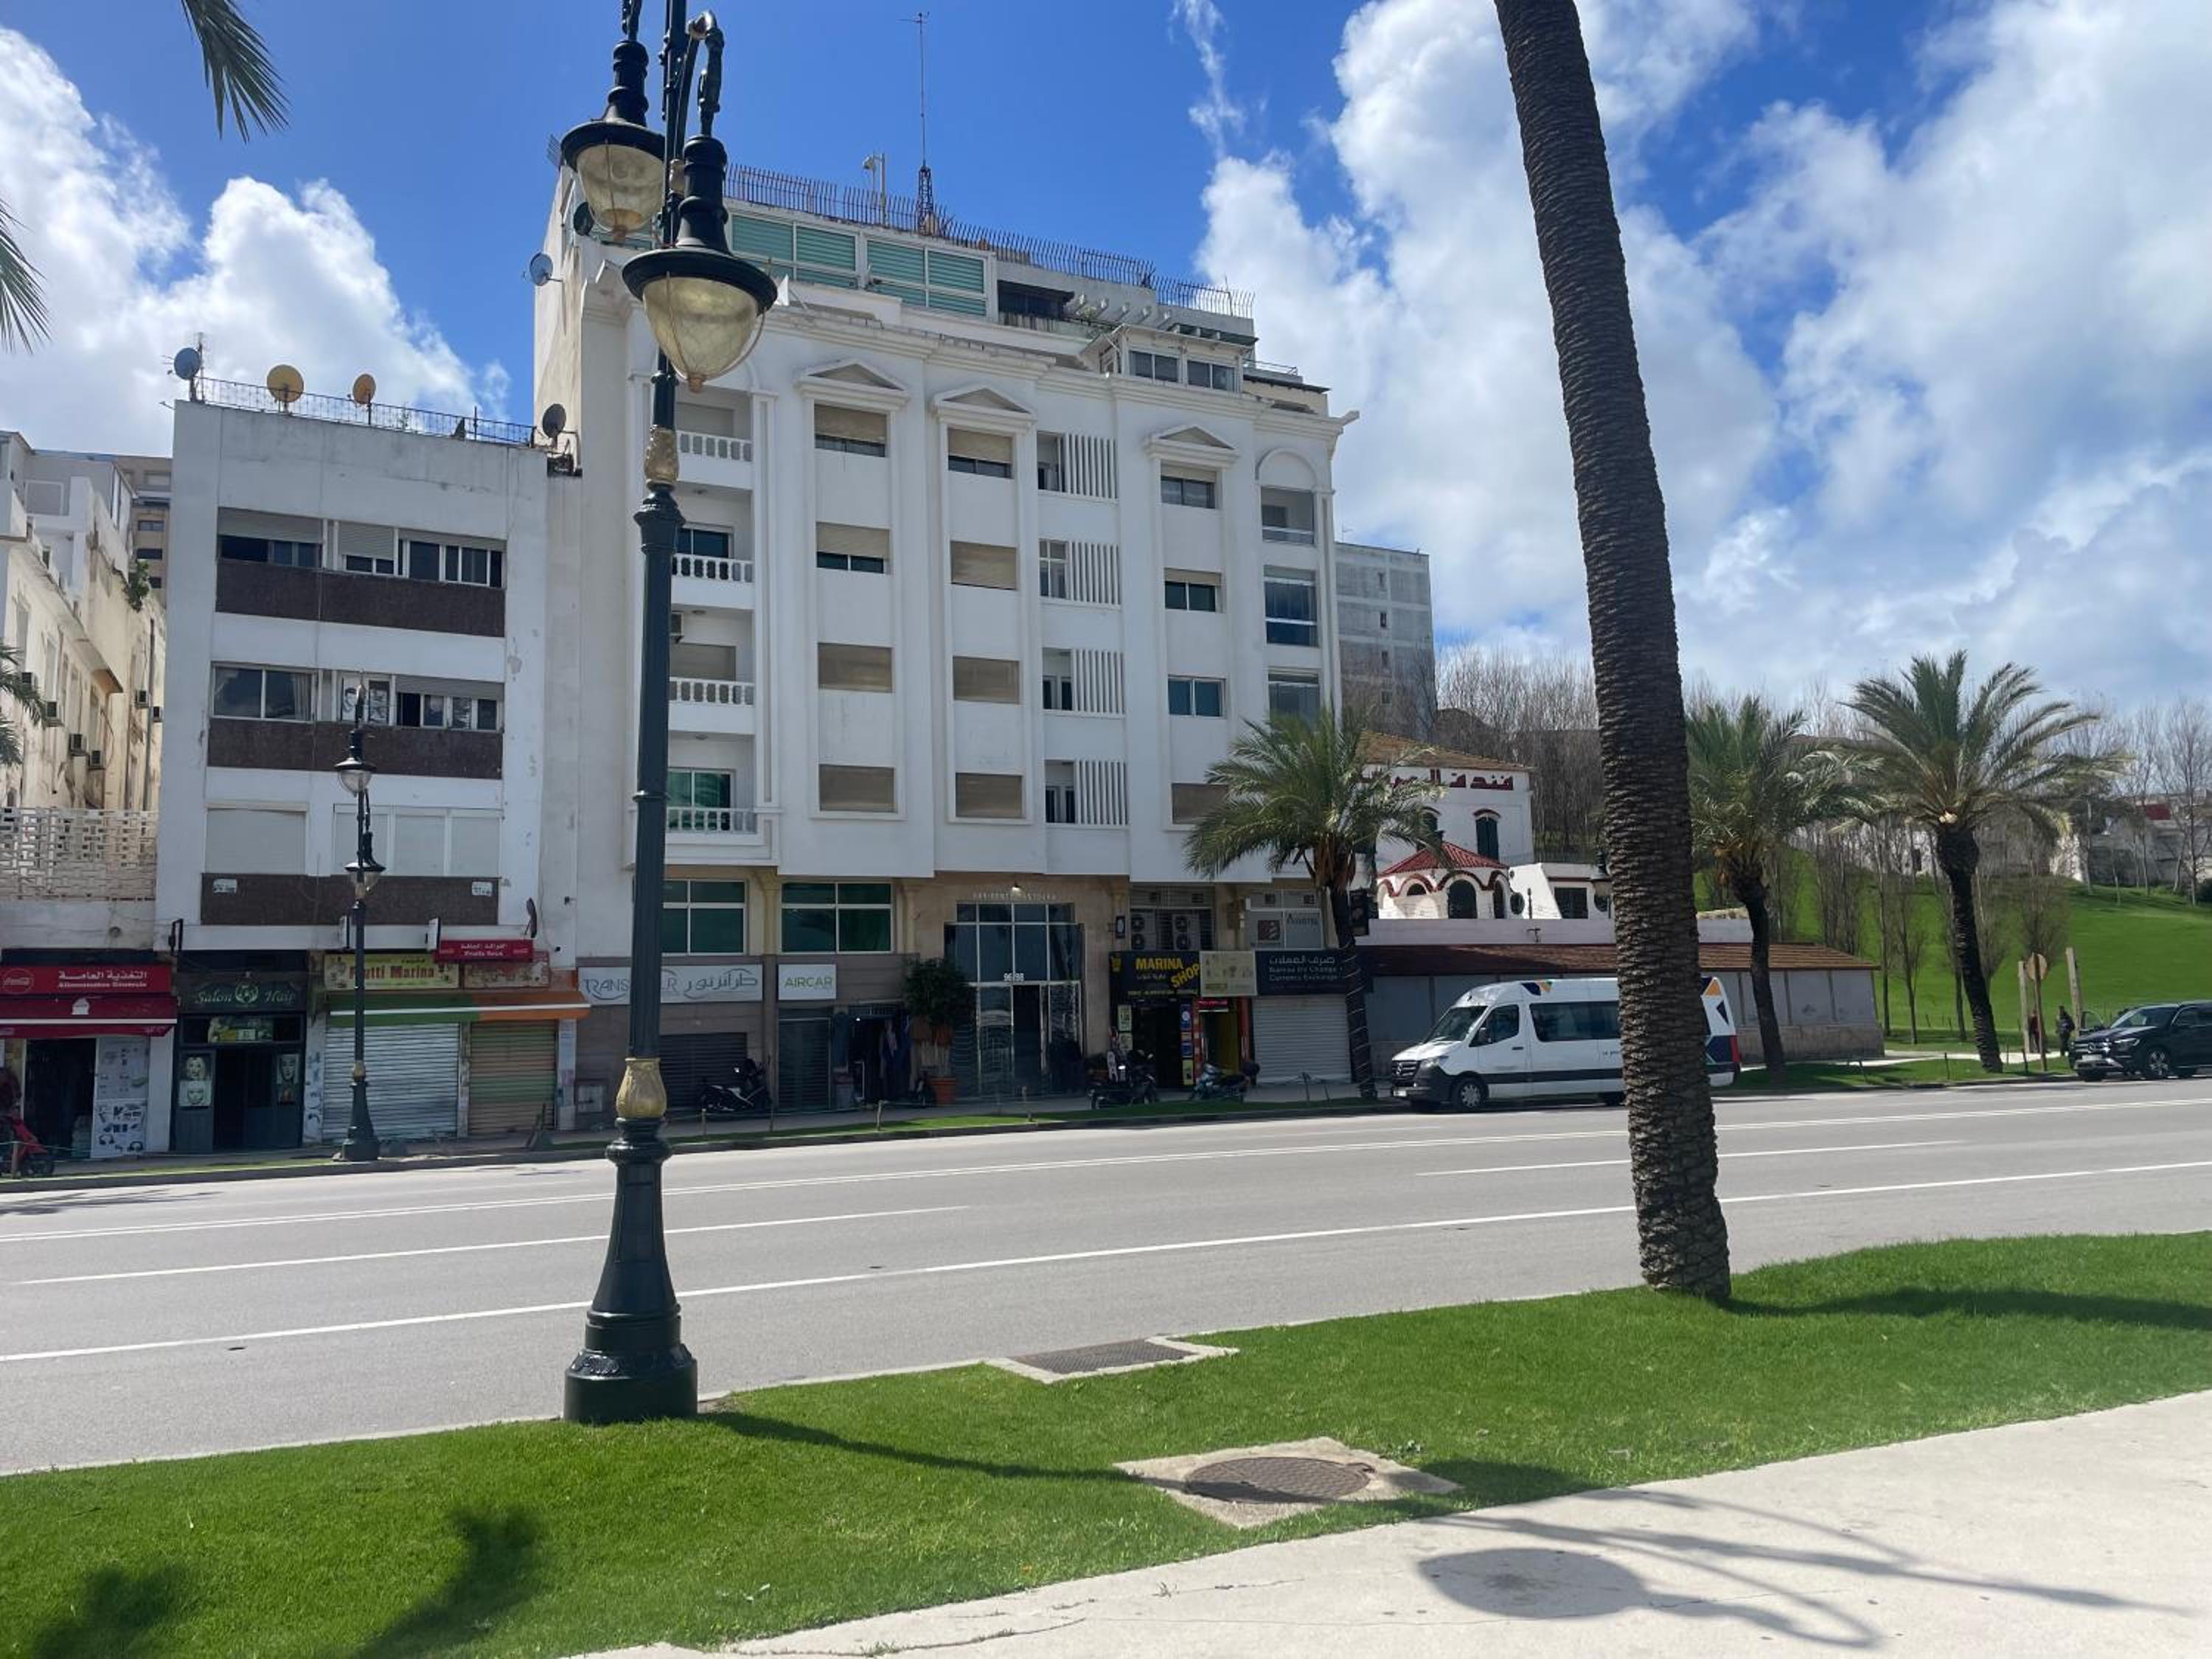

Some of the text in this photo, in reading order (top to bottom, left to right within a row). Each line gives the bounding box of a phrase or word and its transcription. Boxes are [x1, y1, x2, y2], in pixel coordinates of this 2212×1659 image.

[1135, 957, 1183, 970] MARINA
[390, 965, 434, 979] Marina
[1169, 963, 1200, 989] SHOP
[785, 976, 833, 988] AIRCAR
[195, 988, 232, 1004] Salon
